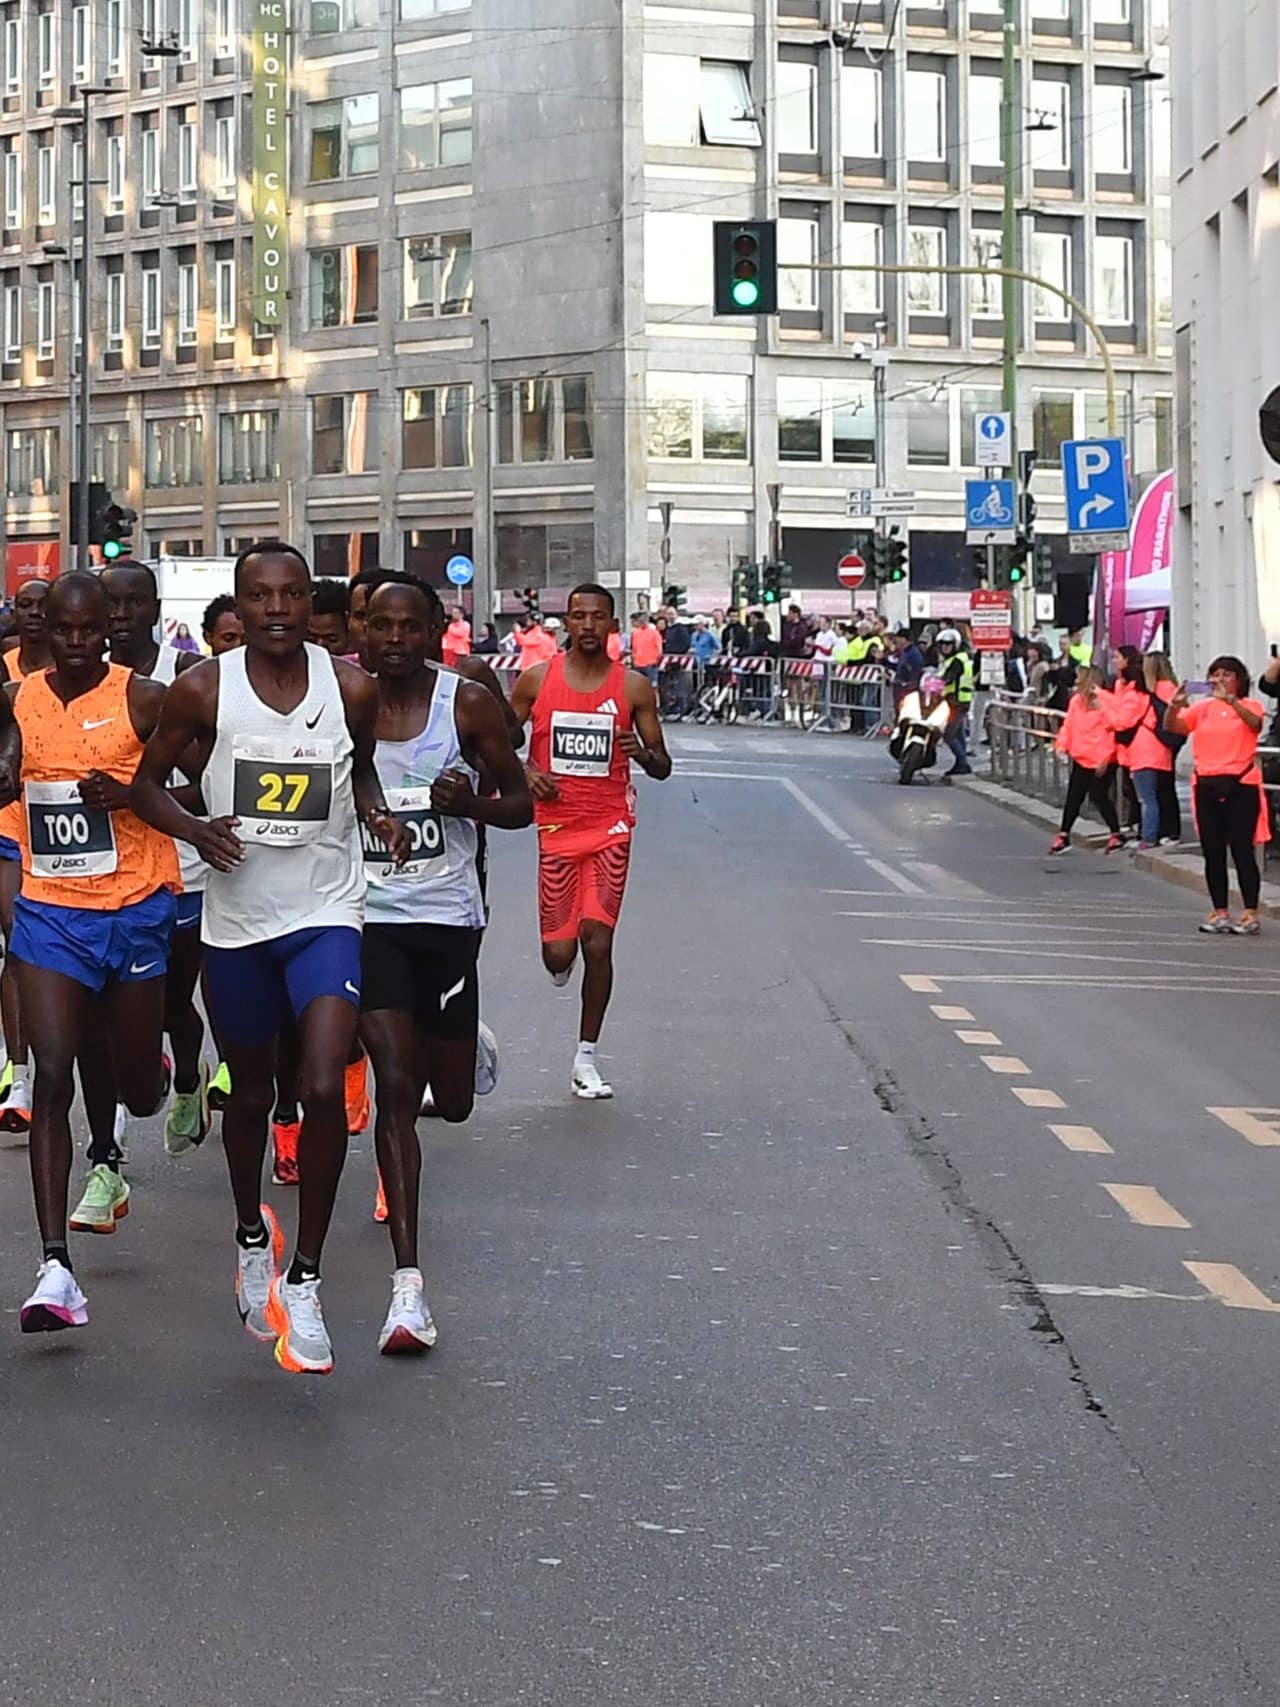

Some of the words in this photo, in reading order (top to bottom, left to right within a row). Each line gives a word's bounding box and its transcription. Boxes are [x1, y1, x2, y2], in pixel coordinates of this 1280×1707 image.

[260, 4, 281, 16] HC
[263, 32, 280, 151] HOTEL
[263, 173, 280, 317] CAVOUR
[1076, 445, 1110, 490] P
[556, 732, 607, 756] YEGON
[256, 773, 309, 812] 27
[43, 813, 89, 845] TOO
[270, 825, 299, 835] asics
